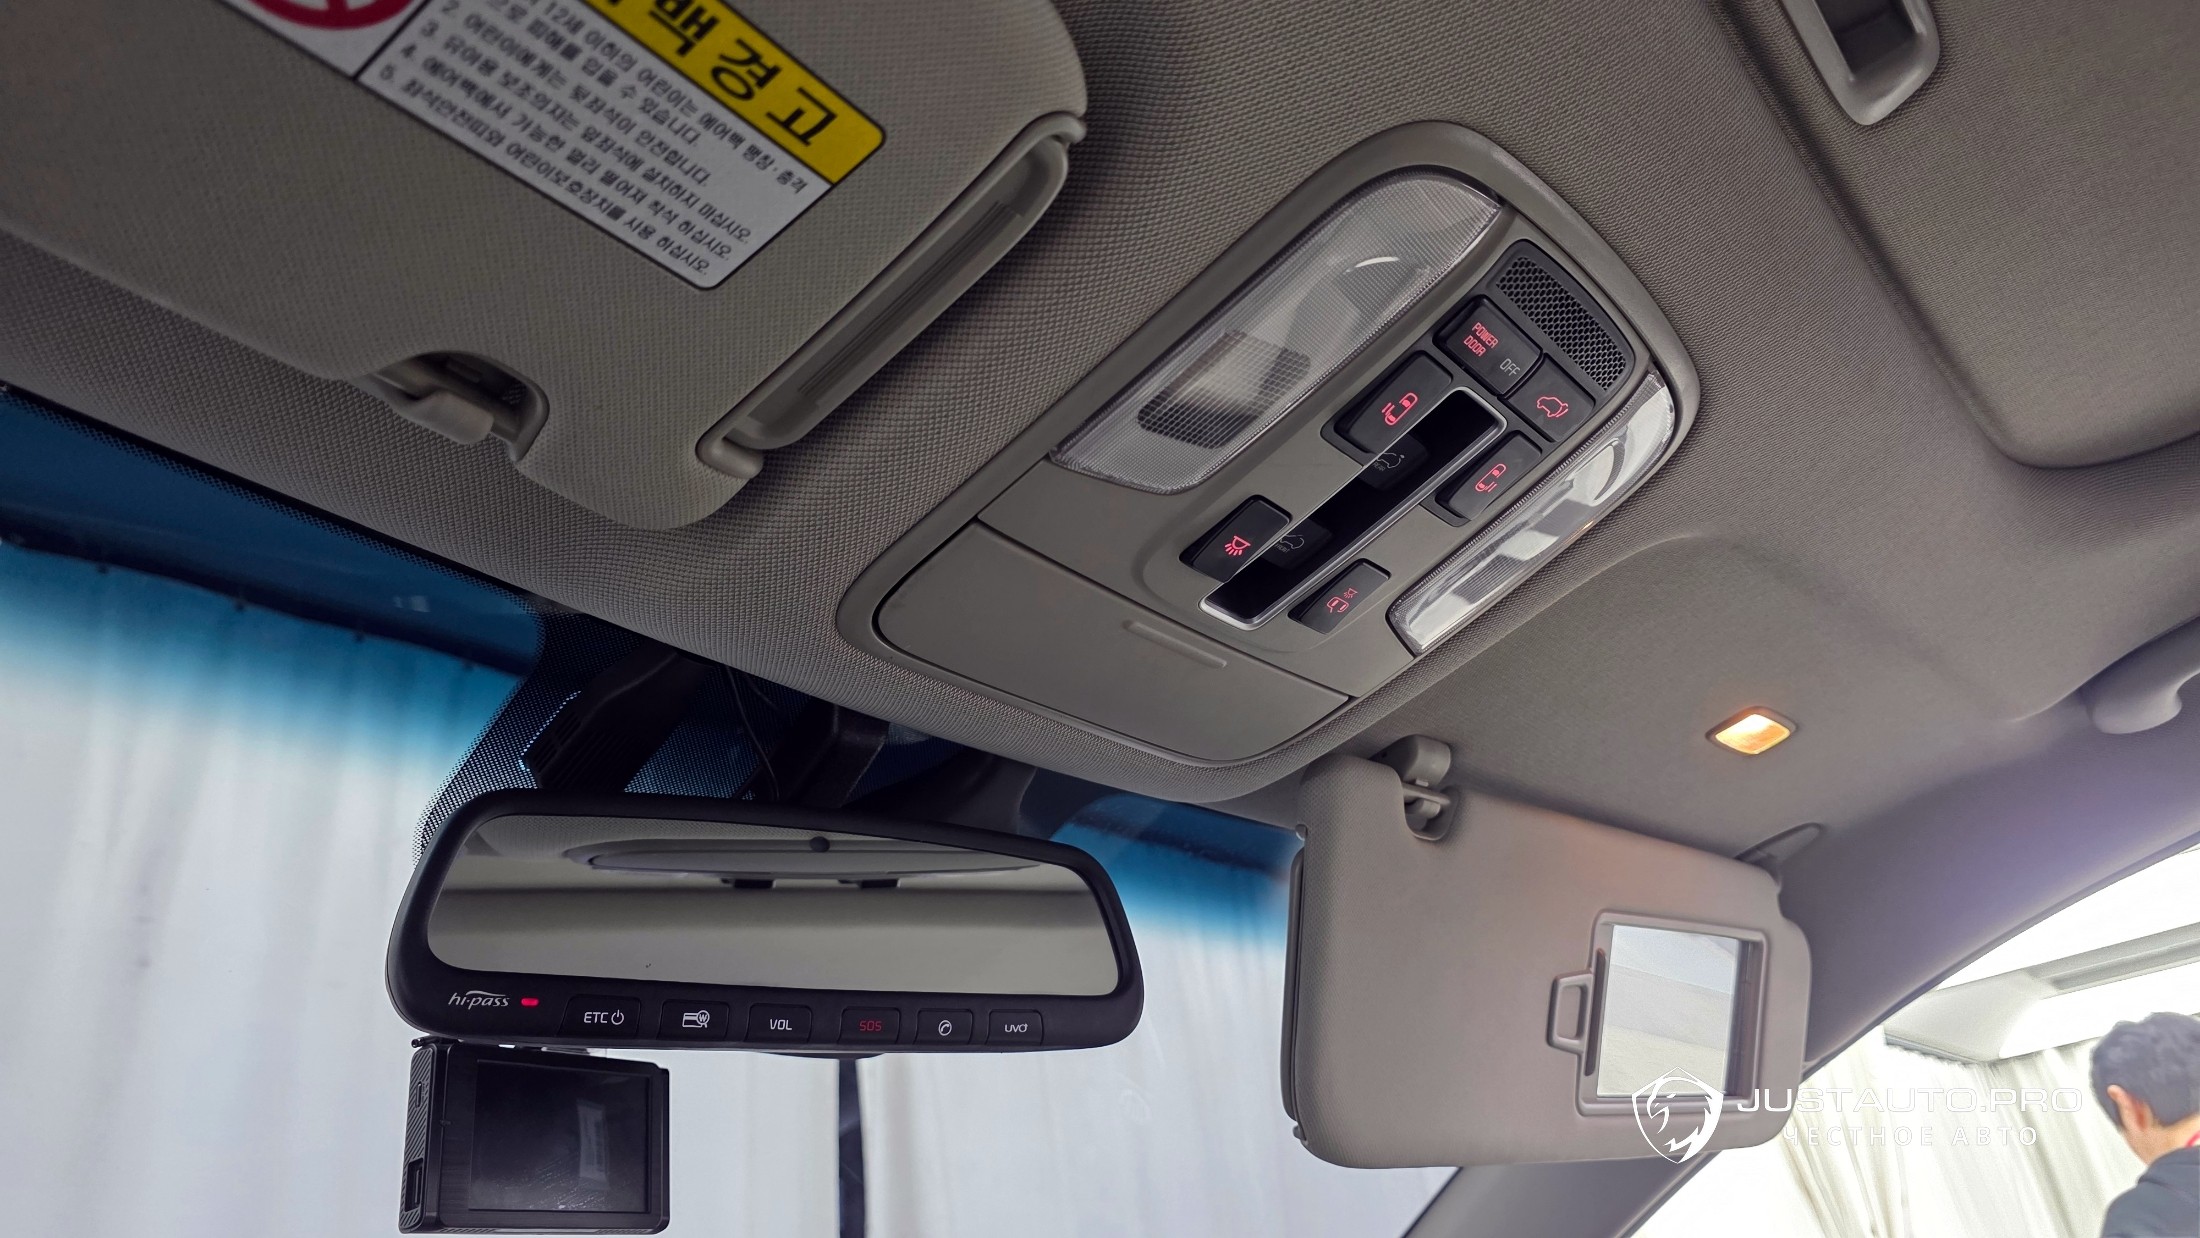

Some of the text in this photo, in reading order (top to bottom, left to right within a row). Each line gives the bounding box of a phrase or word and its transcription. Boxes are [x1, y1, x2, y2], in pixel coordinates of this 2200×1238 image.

[619, 84, 638, 100] 수
[1471, 321, 1499, 349] POWER
[1463, 334, 1487, 357] DOOR
[1499, 358, 1521, 376] OFF
[583, 1011, 609, 1024] ETC
[769, 1018, 793, 1031] VOL
[859, 1020, 882, 1032] SOS
